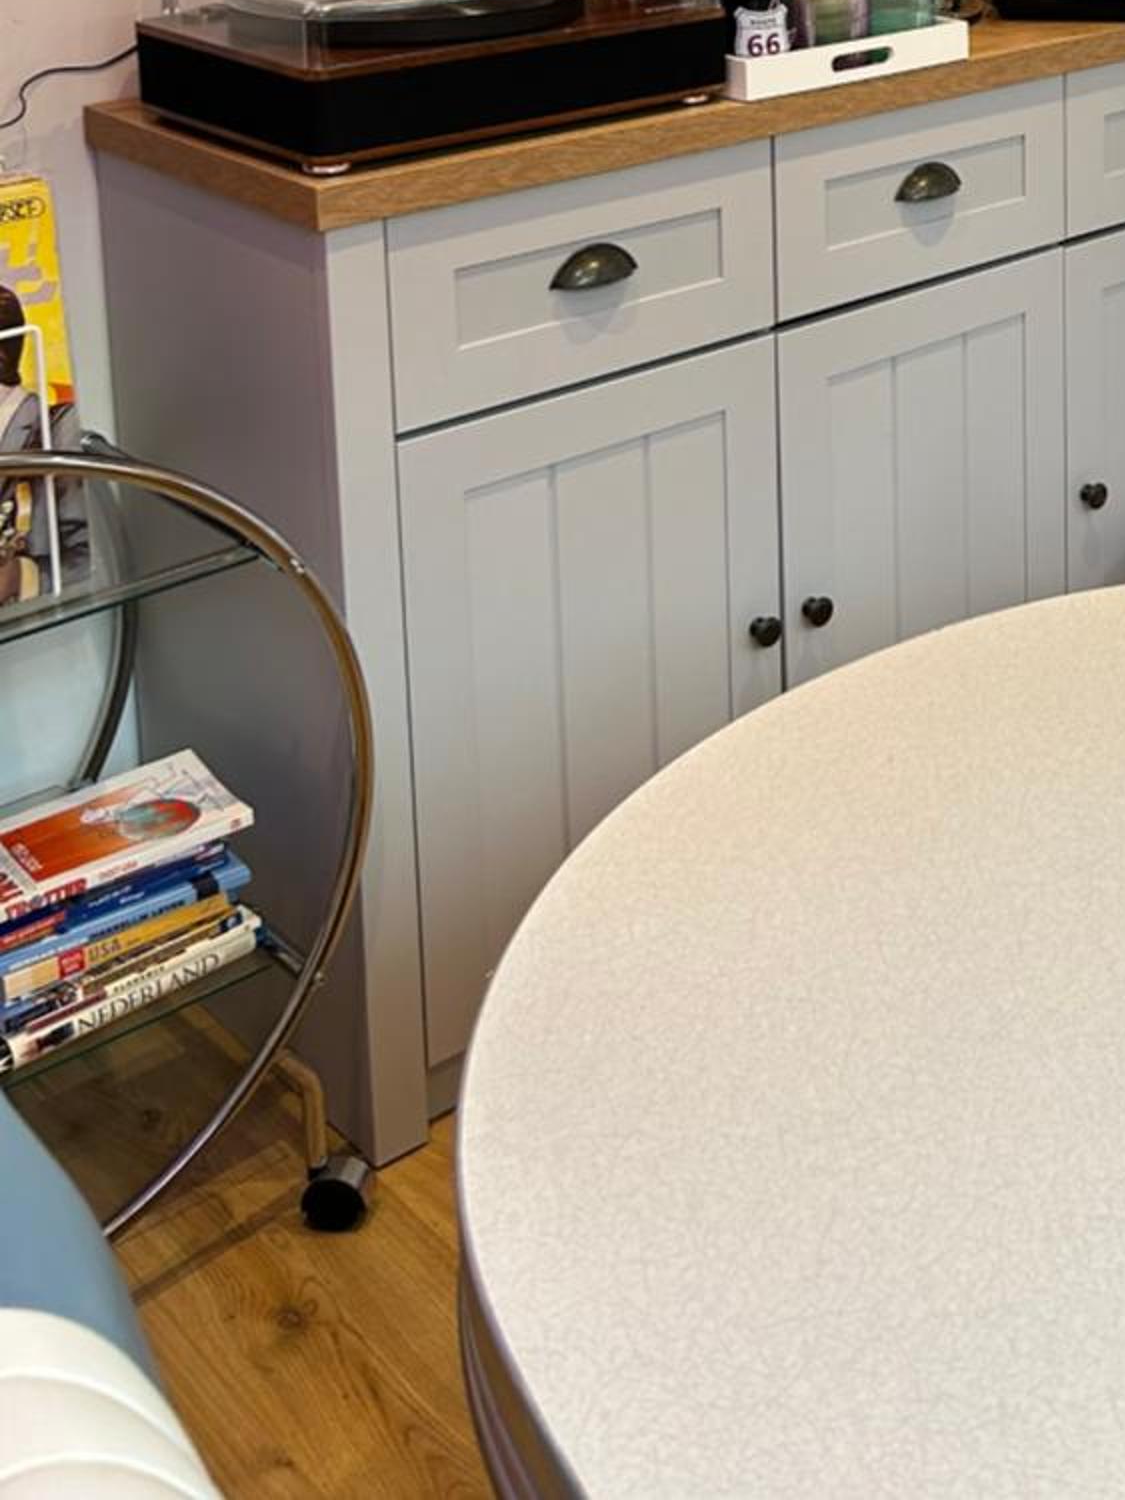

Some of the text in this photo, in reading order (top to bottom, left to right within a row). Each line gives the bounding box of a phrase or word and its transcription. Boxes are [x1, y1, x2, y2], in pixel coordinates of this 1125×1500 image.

[748, 33, 781, 57] 66
[87, 937, 121, 963] USA
[76, 953, 221, 1033] NEDERLAND
